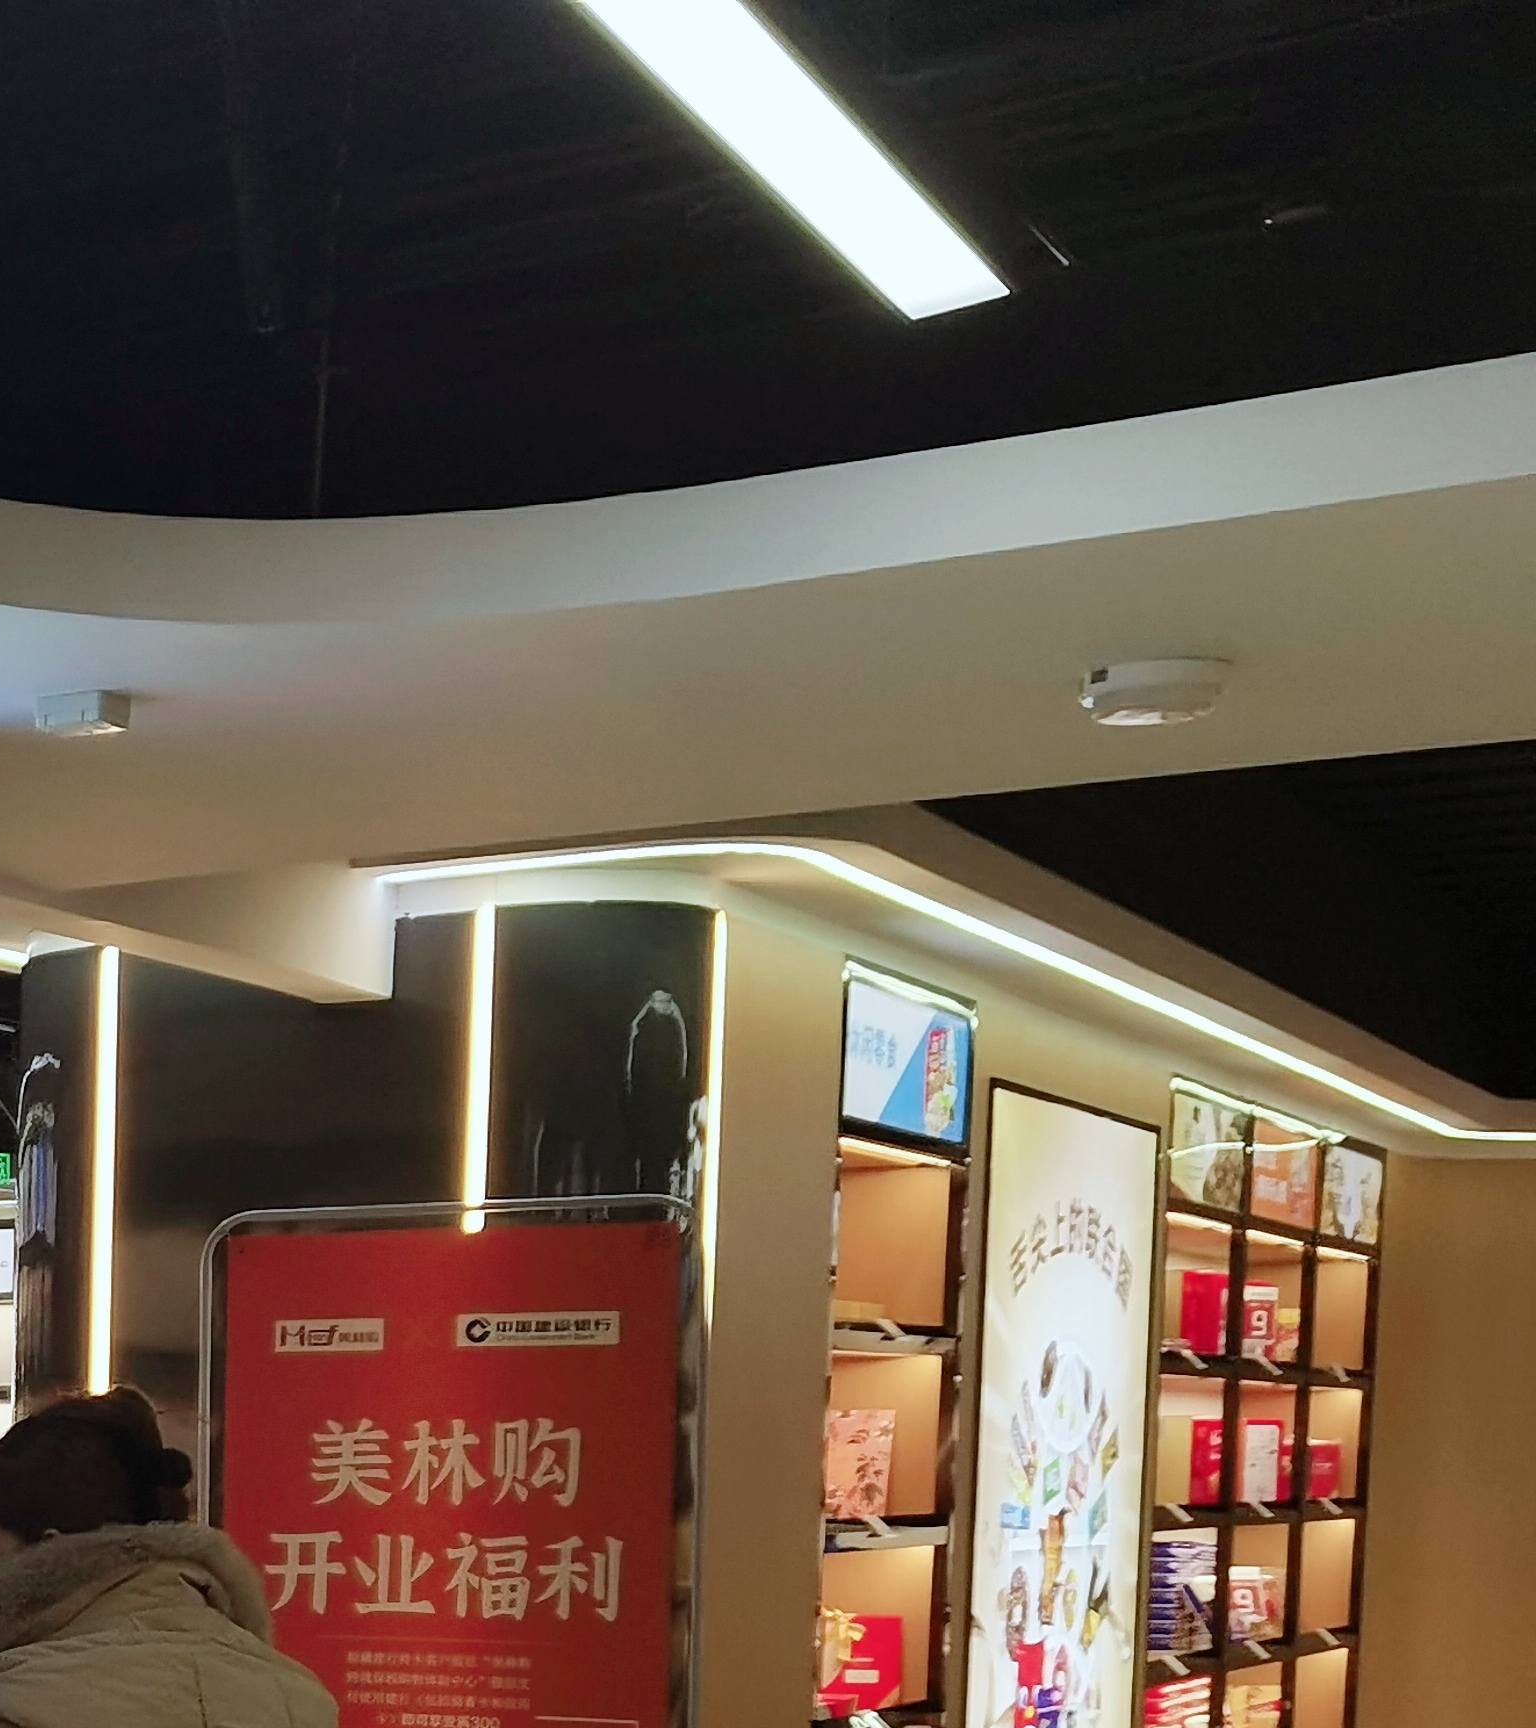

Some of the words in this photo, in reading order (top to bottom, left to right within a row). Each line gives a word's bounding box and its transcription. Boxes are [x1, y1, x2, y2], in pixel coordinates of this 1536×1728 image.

[311, 1417, 583, 1508] 美林购
[264, 1530, 625, 1622] 开业福利
